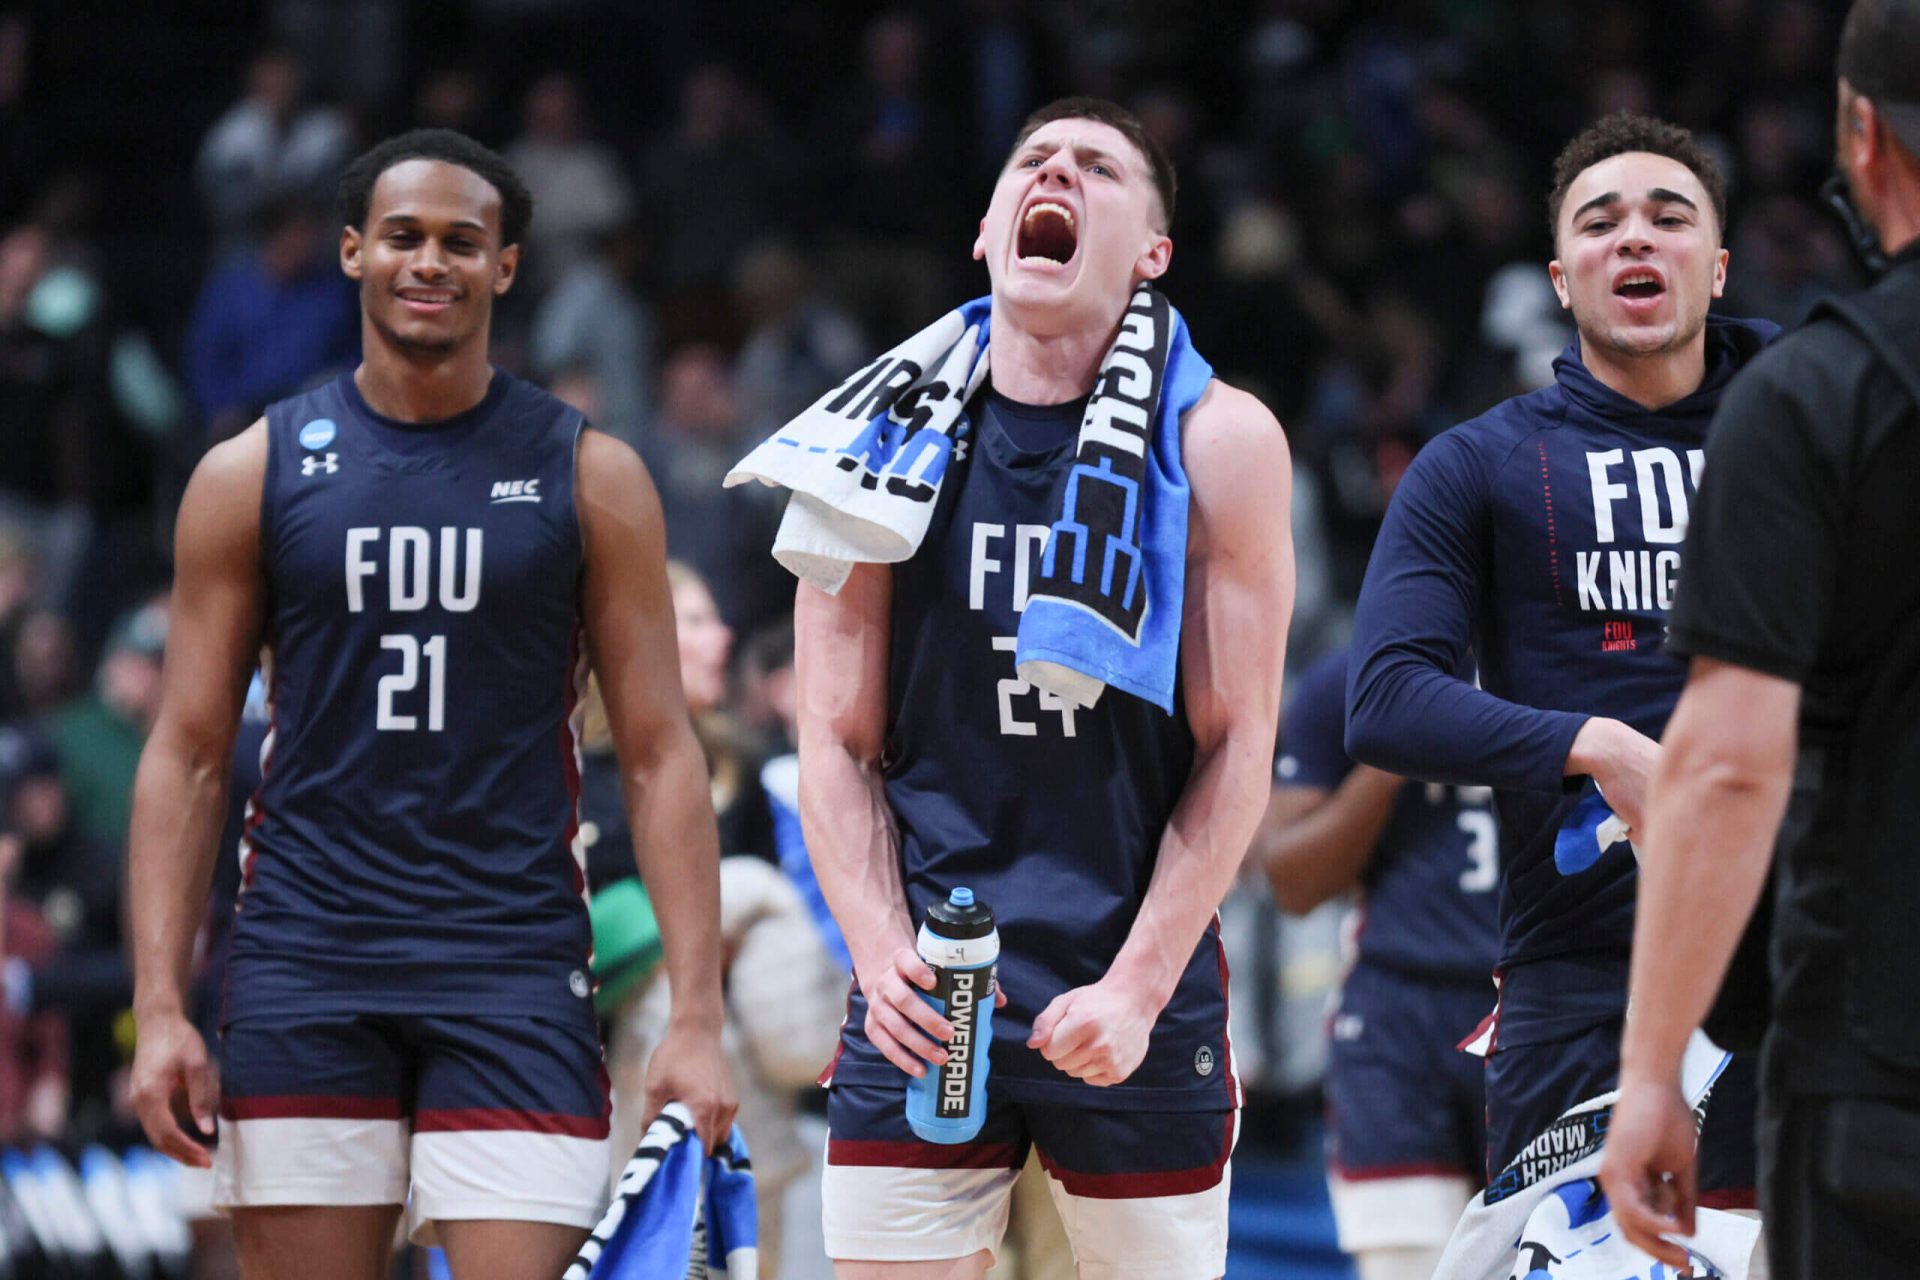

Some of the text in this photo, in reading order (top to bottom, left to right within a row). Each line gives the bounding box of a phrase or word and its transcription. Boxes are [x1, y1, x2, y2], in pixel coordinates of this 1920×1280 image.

[490, 478, 540, 498] NEC
[1585, 446, 1706, 544] FD
[345, 526, 484, 613] FDU
[969, 521, 1053, 613] FD
[1575, 549, 1683, 612] KNIG
[1602, 639, 1637, 652] KNIGHTS
[1604, 621, 1633, 641] FDU
[376, 634, 447, 732] 21
[943, 973, 975, 1112] POWERADE
[1501, 1123, 1587, 1175] MADN
